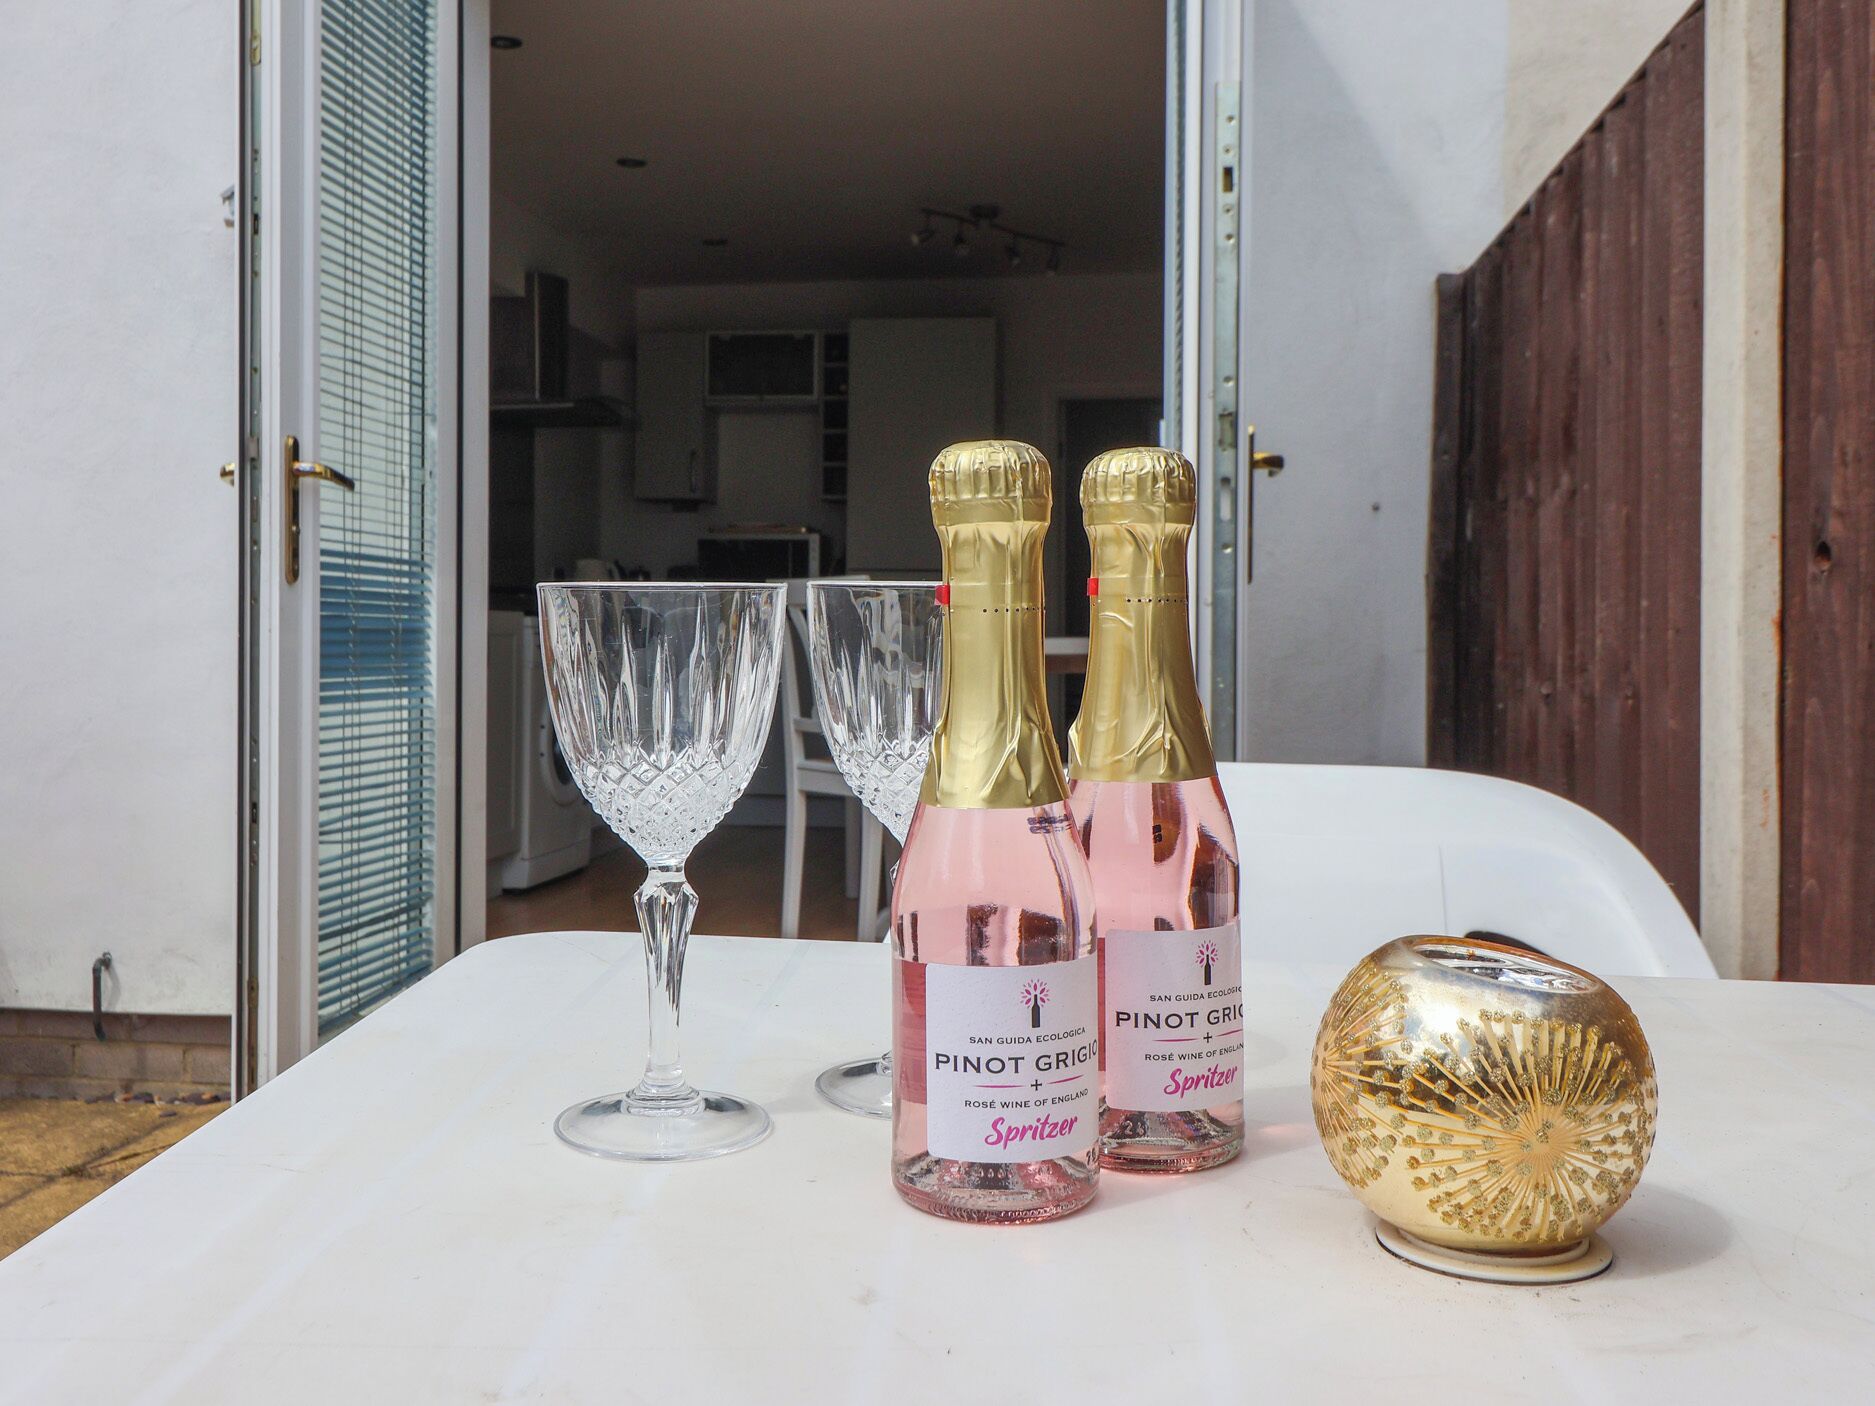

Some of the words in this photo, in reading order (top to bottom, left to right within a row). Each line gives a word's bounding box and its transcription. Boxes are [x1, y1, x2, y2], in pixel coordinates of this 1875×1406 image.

[1149, 994, 1172, 1002] SAN
[1174, 993, 1205, 1002] GUIDA
[1115, 1011, 1199, 1029] PINOT
[969, 1036, 993, 1045] SAN
[996, 1036, 1032, 1045] GUIDA
[1036, 1026, 1086, 1043] ECOLOGICA
[935, 1052, 1025, 1074] PINOT
[1035, 1039, 1098, 1072] GRIGIO
[1144, 1053, 1175, 1061] ROSÉ
[1177, 1052, 1204, 1061] WINE
[1205, 1049, 1218, 1058] OF
[1163, 1064, 1238, 1099] Spritzer
[964, 1099, 996, 1109] ROSÉ
[1000, 1100, 1031, 1109] WINE
[1034, 1099, 1048, 1107] OF
[1051, 1088, 1089, 1105] ENGLAND
[984, 1113, 1078, 1150] Spritzer
